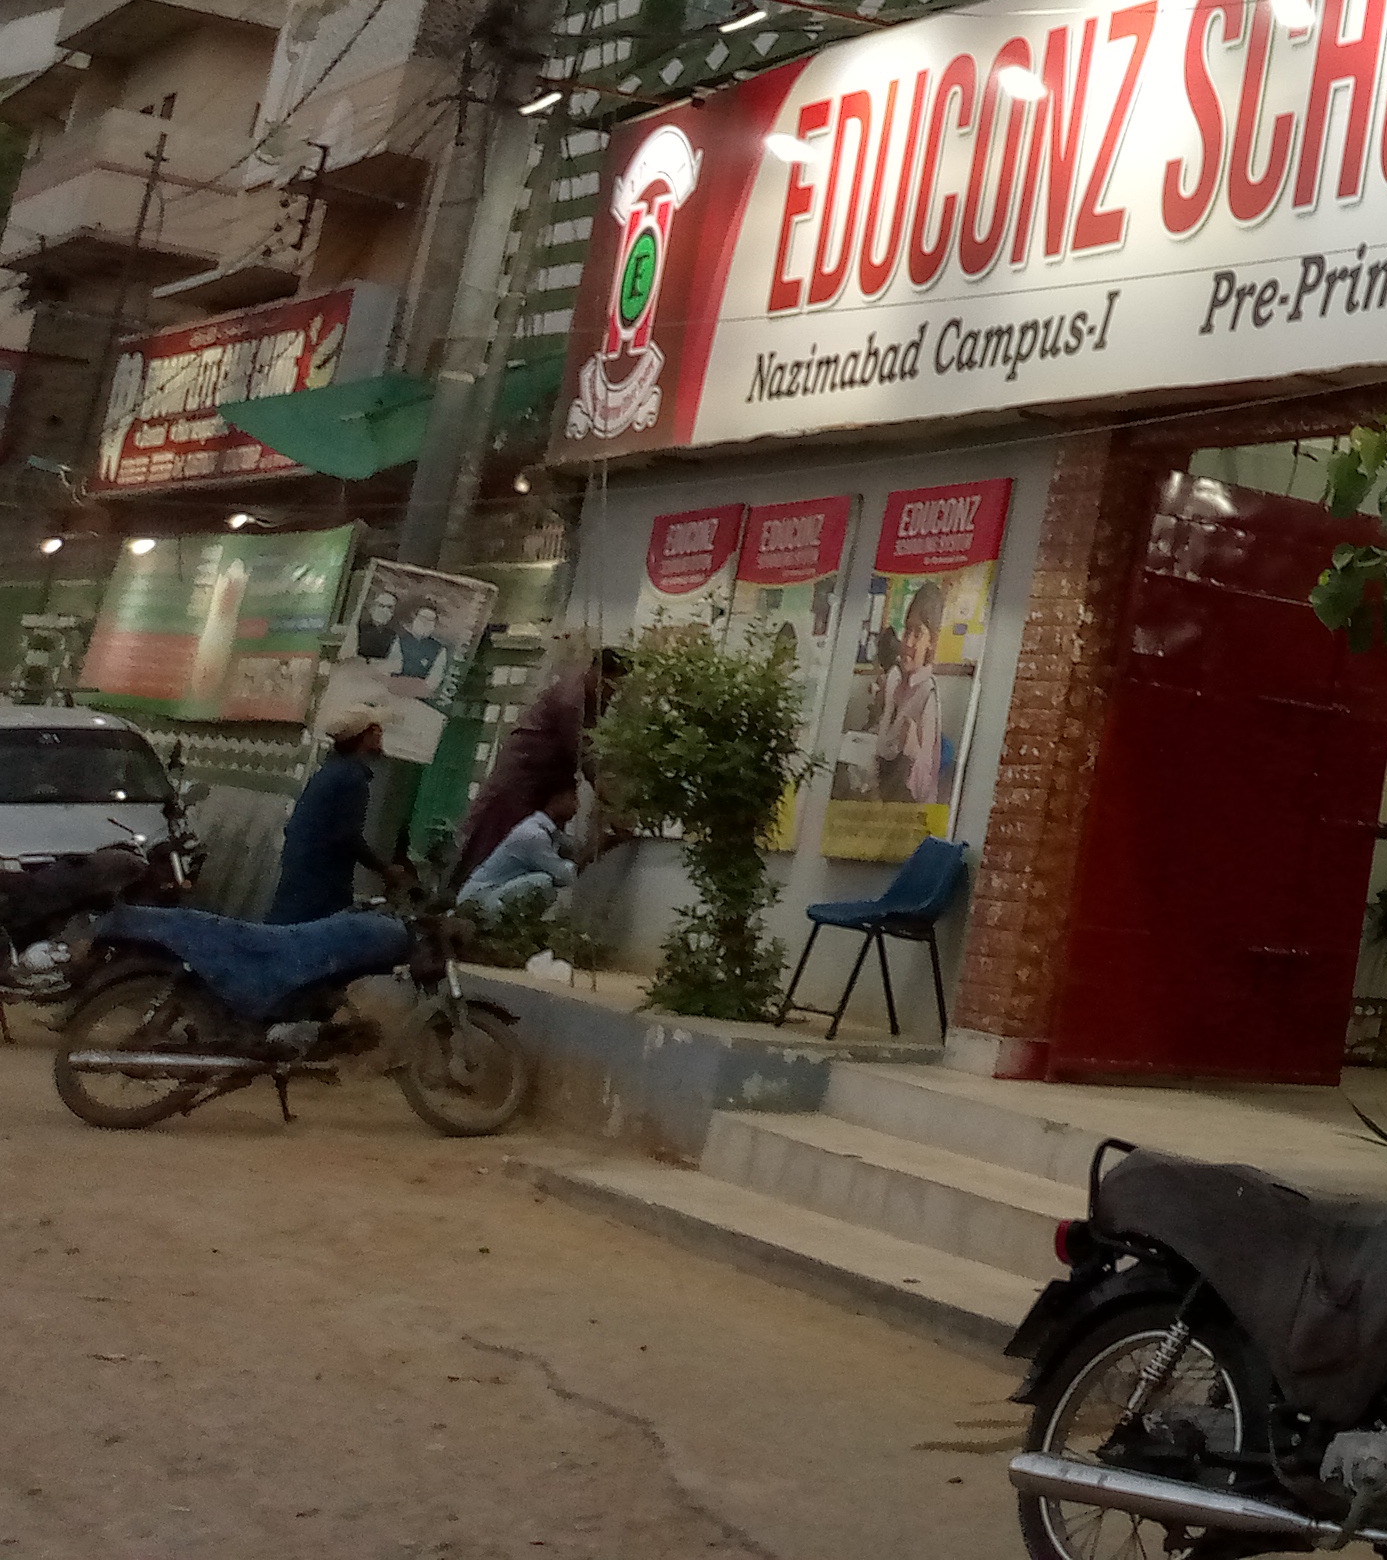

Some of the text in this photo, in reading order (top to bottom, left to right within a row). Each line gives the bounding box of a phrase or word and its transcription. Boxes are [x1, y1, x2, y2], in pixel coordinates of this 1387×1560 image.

[766, 0, 1159, 313] EDUCONZ
[745, 320, 928, 405] Nazimabad
[934, 290, 1121, 382] Campus-I
